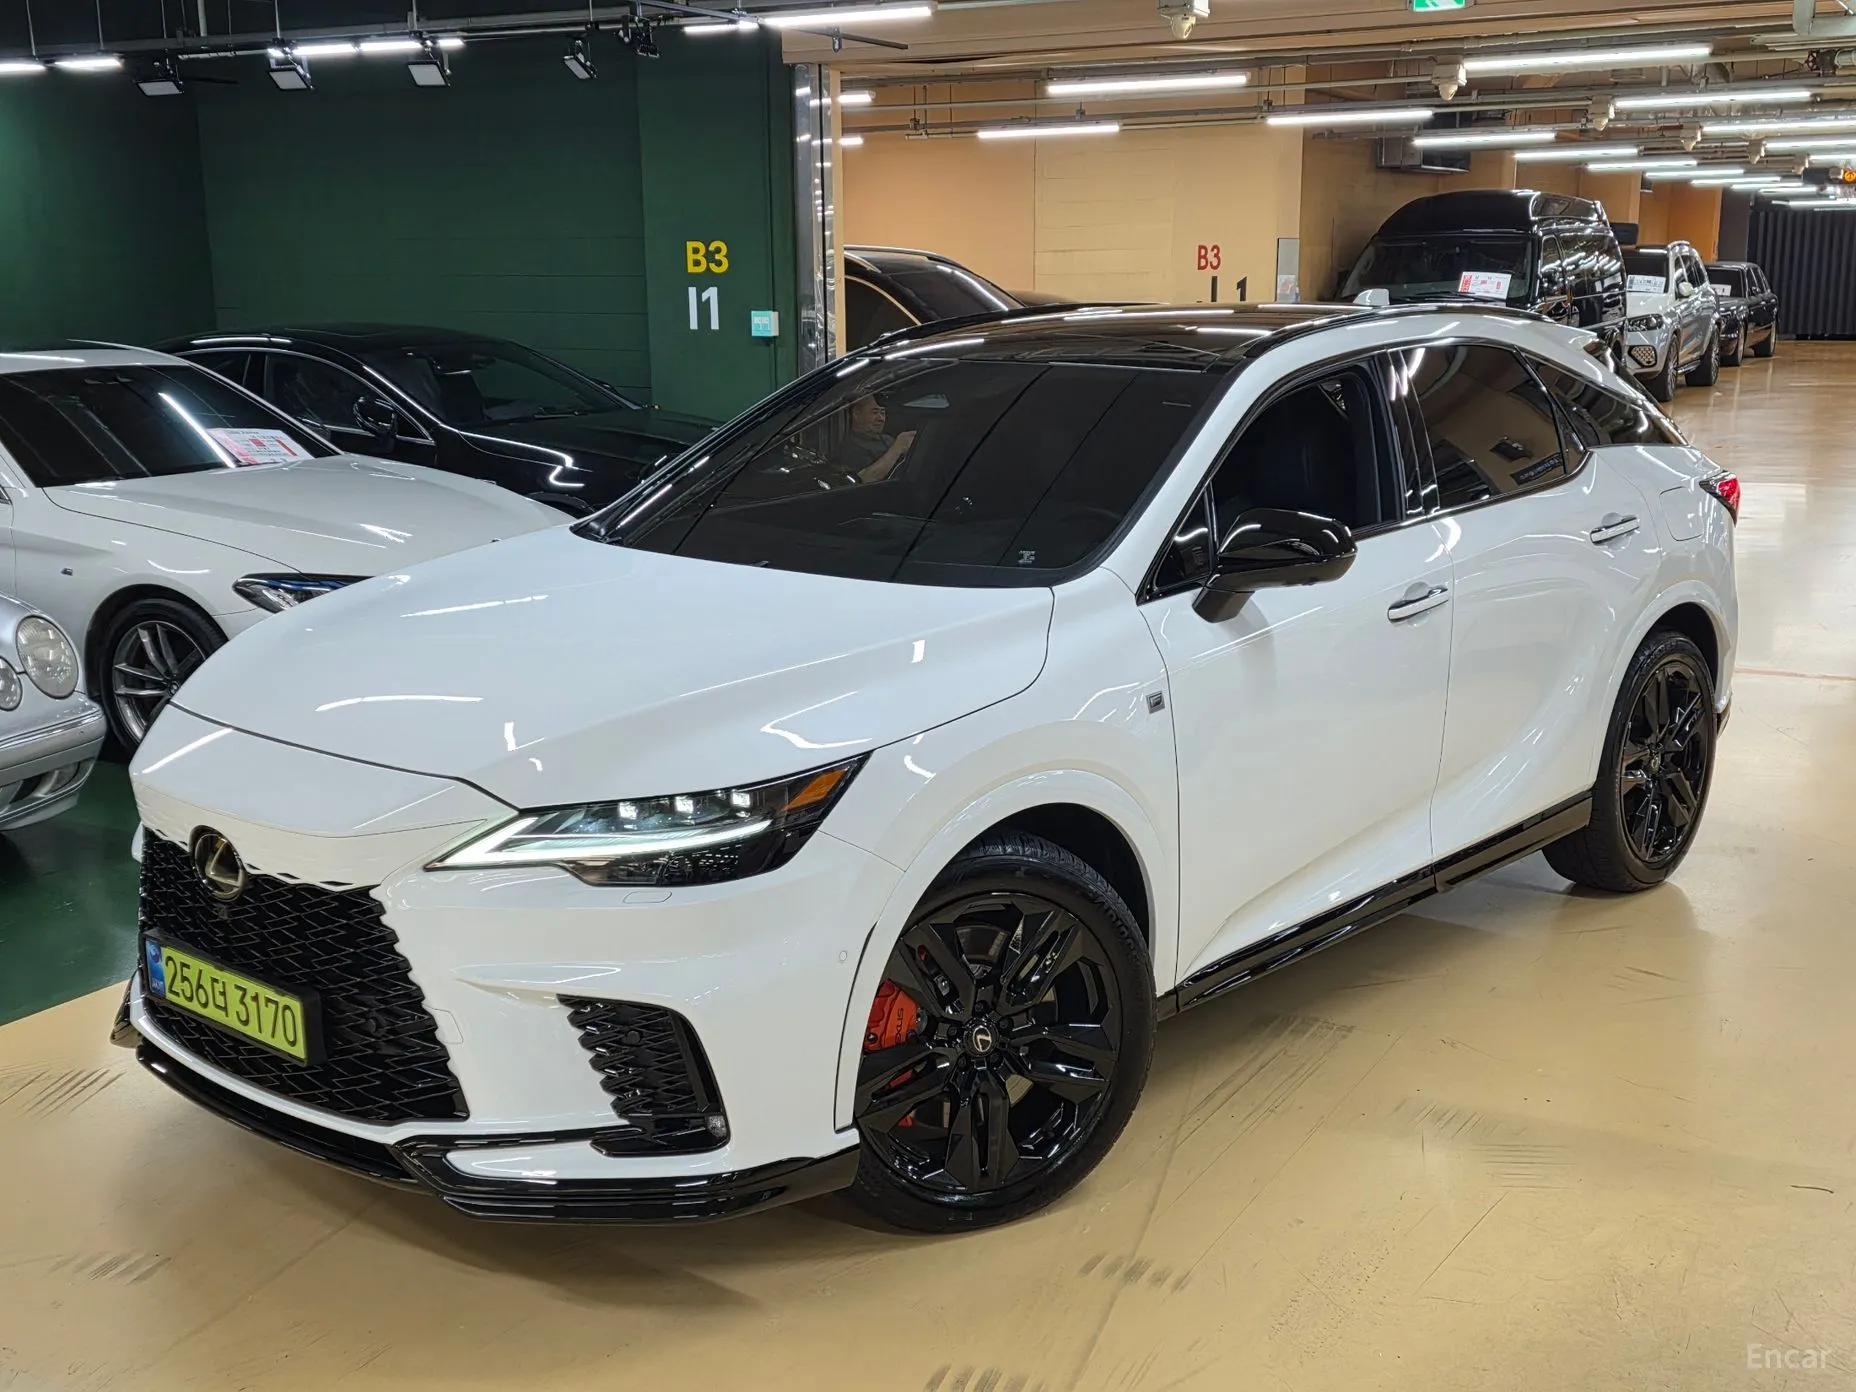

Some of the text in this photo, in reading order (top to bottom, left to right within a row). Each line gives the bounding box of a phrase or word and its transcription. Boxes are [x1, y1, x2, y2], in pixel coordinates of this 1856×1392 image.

[686, 240, 729, 274] B3
[1197, 244, 1221, 270] B3
[234, 983, 298, 1048] 3170
